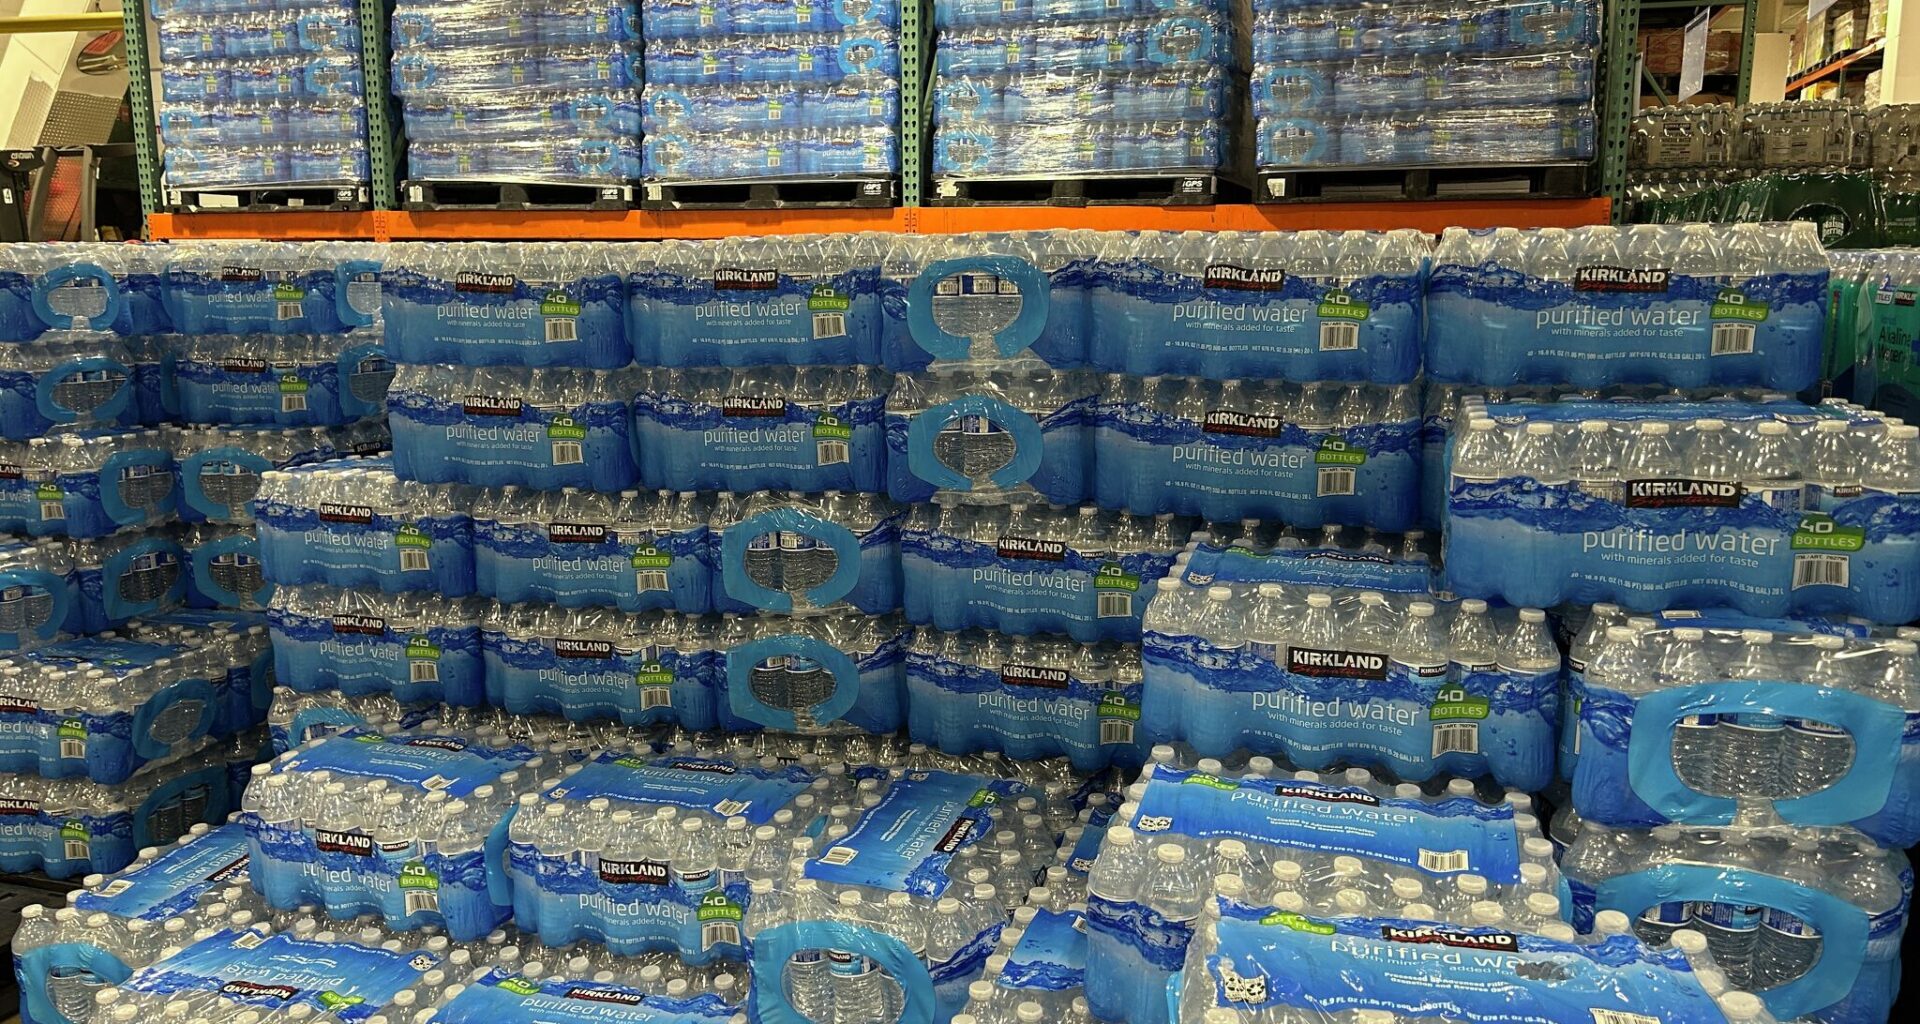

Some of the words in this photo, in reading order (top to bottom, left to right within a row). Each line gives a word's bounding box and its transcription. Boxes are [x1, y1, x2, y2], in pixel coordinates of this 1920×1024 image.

[457, 274, 513, 286] KIRKLAND
[715, 270, 776, 282] KIRKLAND
[1207, 267, 1282, 283] KIRKLAND
[1580, 268, 1666, 284] KIRKLAND
[546, 293, 566, 303] 40
[813, 288, 834, 297] 40
[1324, 293, 1350, 304] 40
[1718, 292, 1744, 305] 40
[695, 301, 751, 320] purified
[757, 303, 800, 317] water
[811, 300, 847, 309] BOTTLES
[437, 303, 490, 320] purified
[495, 305, 533, 319] water
[1173, 301, 1246, 322] purified
[1252, 305, 1308, 323] water
[1321, 306, 1365, 318] BOTTLES
[1536, 305, 1623, 329] purified
[1631, 308, 1701, 326] water
[1713, 307, 1762, 319] BOTTLES
[1237, 324, 1260, 332] added
[1263, 324, 1273, 332] for
[1276, 325, 1295, 333] taste
[1551, 328, 1572, 336] with
[1574, 329, 1611, 337] minerals
[1613, 329, 1640, 337] added
[1643, 328, 1656, 336] for
[1659, 329, 1684, 337] taste
[465, 398, 520, 410] KIRKLAND
[724, 399, 784, 409] KIRKLAND
[553, 418, 573, 427] 40
[817, 416, 838, 426] 40
[1207, 412, 1279, 429] KIRKLAND
[446, 425, 498, 441] purified
[503, 429, 540, 443] water
[551, 428, 584, 438] BOTTLES
[704, 428, 759, 446] purified
[764, 430, 805, 443] water
[1322, 439, 1345, 451] 40
[1173, 443, 1244, 464] purified
[1250, 449, 1307, 468] water
[1319, 453, 1362, 463] BOTTLES
[1185, 462, 1200, 471] with
[1202, 463, 1233, 475] minerals
[1234, 466, 1259, 476] added
[1261, 468, 1272, 477] for
[1274, 469, 1294, 478] taste
[1632, 482, 1736, 496] KIRKLAND
[321, 505, 371, 517] KIRKLAND
[400, 526, 419, 535] 40
[551, 525, 603, 536] KIRKLAND
[1800, 519, 1833, 533] 40
[304, 529, 351, 546] purified
[355, 535, 387, 550] water
[1583, 528, 1686, 553] purified
[1695, 531, 1780, 556] water
[1796, 536, 1856, 547] BOTTLES
[636, 547, 656, 555] 40
[999, 539, 1062, 554] KIRKLAND
[533, 556, 581, 572] purified
[587, 557, 625, 572] water
[634, 557, 669, 565] BOTTLES
[1601, 552, 1625, 562] with
[1627, 554, 1672, 566] minerals
[1674, 553, 1706, 564] added
[1710, 553, 1726, 563] for
[1729, 557, 1759, 568] taste
[1100, 565, 1121, 576] 40
[973, 567, 1033, 586] purified
[1039, 572, 1086, 592] water
[1098, 578, 1137, 589] BOTTLES
[410, 638, 429, 647] 40
[556, 640, 610, 652] KIRKLAND
[1293, 650, 1383, 669] KIRKLAND
[640, 664, 660, 673] 40
[1003, 666, 1067, 682] KIRKLAND
[538, 668, 587, 686] purified
[592, 672, 630, 689] water
[638, 675, 672, 683] BOTTLES
[1103, 695, 1125, 706] 40
[1438, 690, 1463, 701] 40
[978, 692, 1038, 713] purified
[1043, 699, 1090, 721] water
[1252, 691, 1340, 718] purified
[1348, 699, 1420, 726] water
[1434, 707, 1482, 716] BOTTLES
[63, 720, 81, 728] 40
[1268, 711, 1288, 723] with
[1290, 717, 1328, 729] minerals
[1329, 721, 1359, 729] added
[1362, 721, 1376, 730] for
[1379, 723, 1403, 736] taste
[676, 762, 736, 774] KIRKLAND
[632, 768, 697, 782] purified
[699, 774, 749, 784] water
[1281, 787, 1375, 802] KIRKLAND
[1231, 791, 1332, 814] purified
[1341, 806, 1418, 823] water
[65, 822, 84, 830] 40
[317, 833, 370, 849] KIRKLAND
[944, 819, 975, 852] KIRKLAND
[403, 864, 426, 876] 40
[601, 862, 666, 877] KIRKLAND
[702, 896, 727, 906] 40
[579, 893, 639, 918] purified
[645, 901, 690, 925] water
[701, 907, 742, 919] BOTTLES
[1331, 941, 1463, 965] purified
[223, 984, 292, 999] KIRKLAND
[571, 988, 641, 1002] KIRKLAND
[520, 997, 594, 1015] purified
[599, 1004, 655, 1023] water
